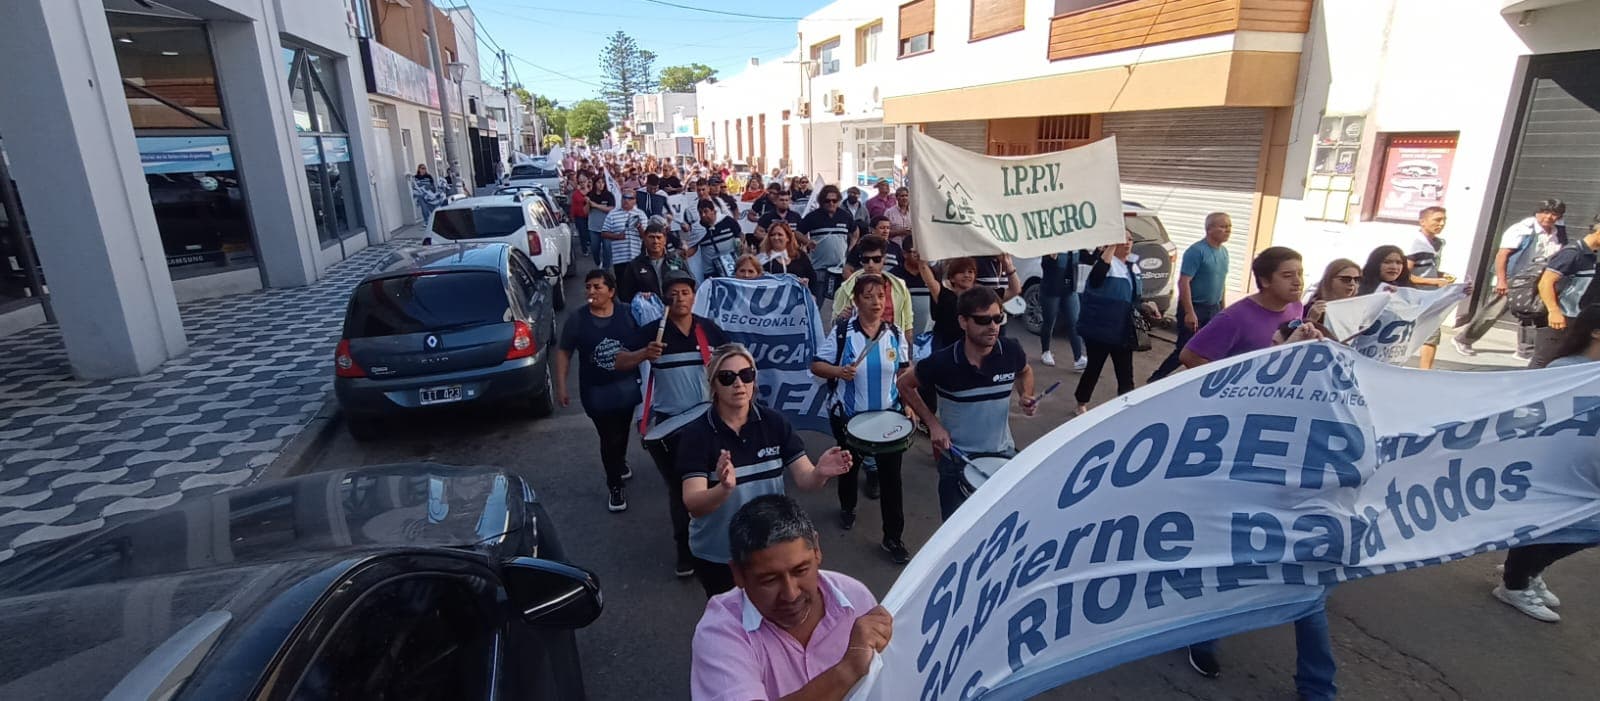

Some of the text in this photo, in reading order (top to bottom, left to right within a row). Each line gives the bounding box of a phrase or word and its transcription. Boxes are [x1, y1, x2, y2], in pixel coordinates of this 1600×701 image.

[1002, 162, 1064, 197] I.P.P.V.
[1021, 200, 1097, 241] NEGRO
[721, 313, 795, 328] SECCIONAL
[1219, 385, 1370, 408] SECCIONAL RIO NEG
[917, 510, 1030, 673] Sra.
[919, 511, 1195, 701] Gobierne
[1230, 505, 1386, 565] para
[1385, 458, 1533, 541] todos
